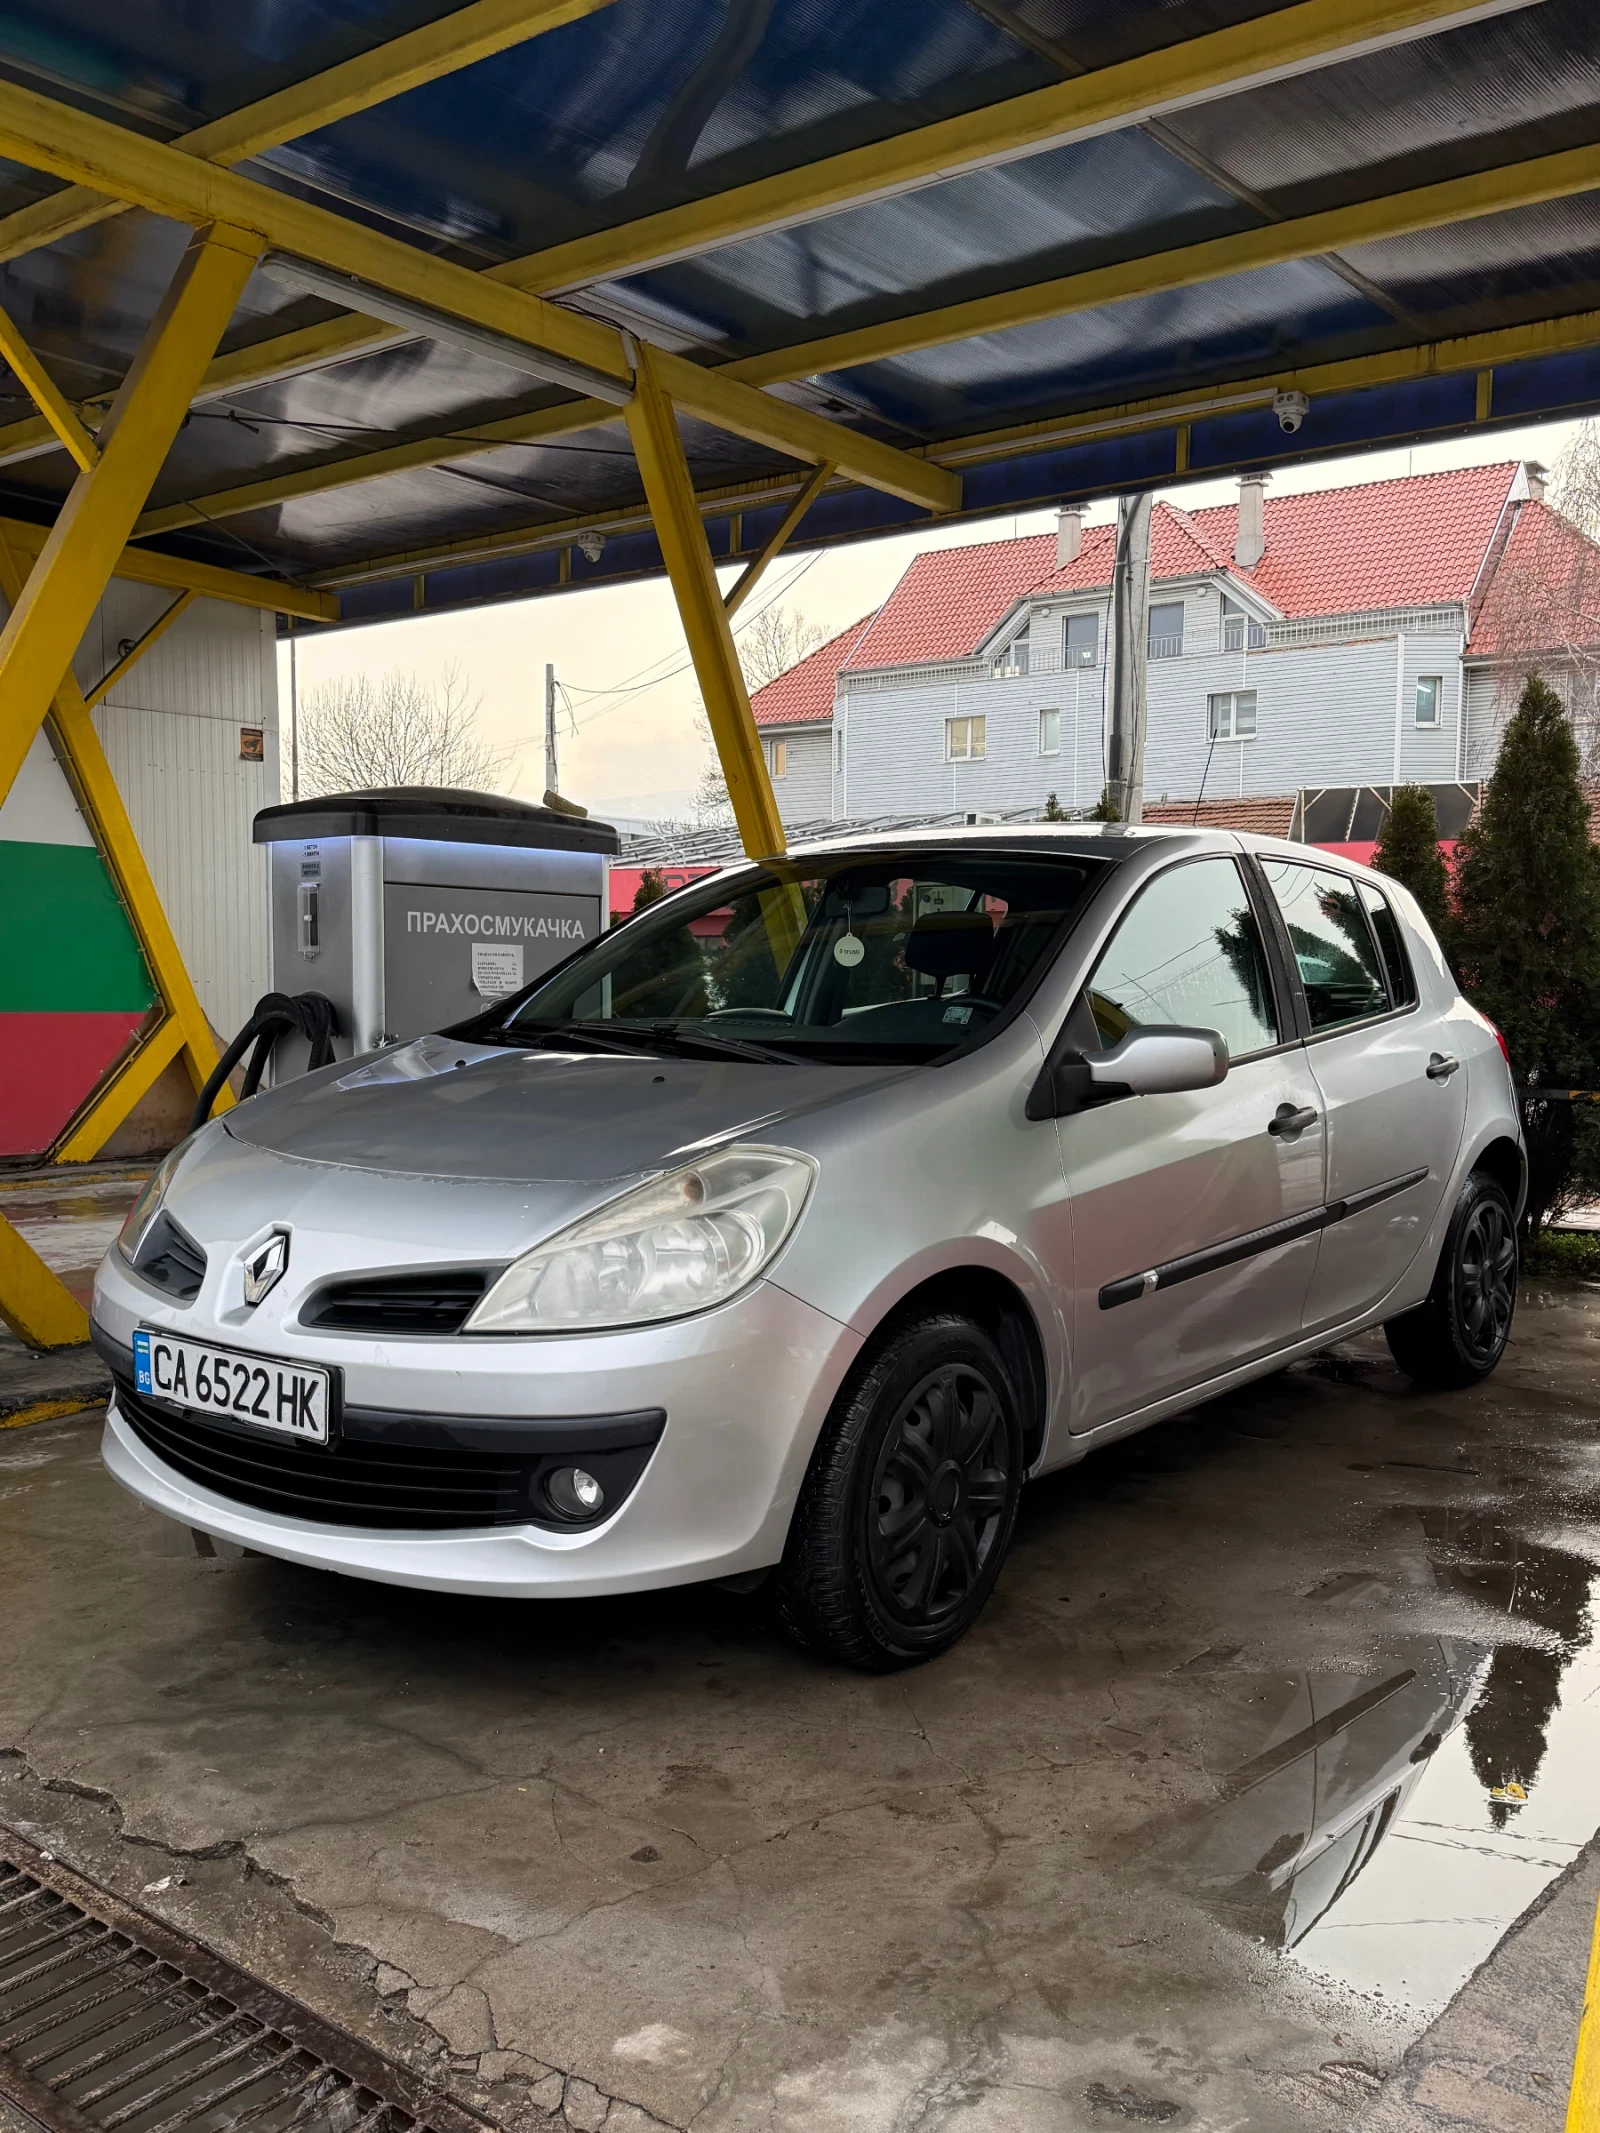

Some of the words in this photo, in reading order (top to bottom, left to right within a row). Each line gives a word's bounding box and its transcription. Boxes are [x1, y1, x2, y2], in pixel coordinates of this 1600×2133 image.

[407, 910, 585, 940] ПРАХОСМУКАЧКА
[138, 1370, 151, 1386] BG
[154, 1344, 189, 1399] CA
[195, 1354, 270, 1419] 6522
[276, 1371, 320, 1432] HK
